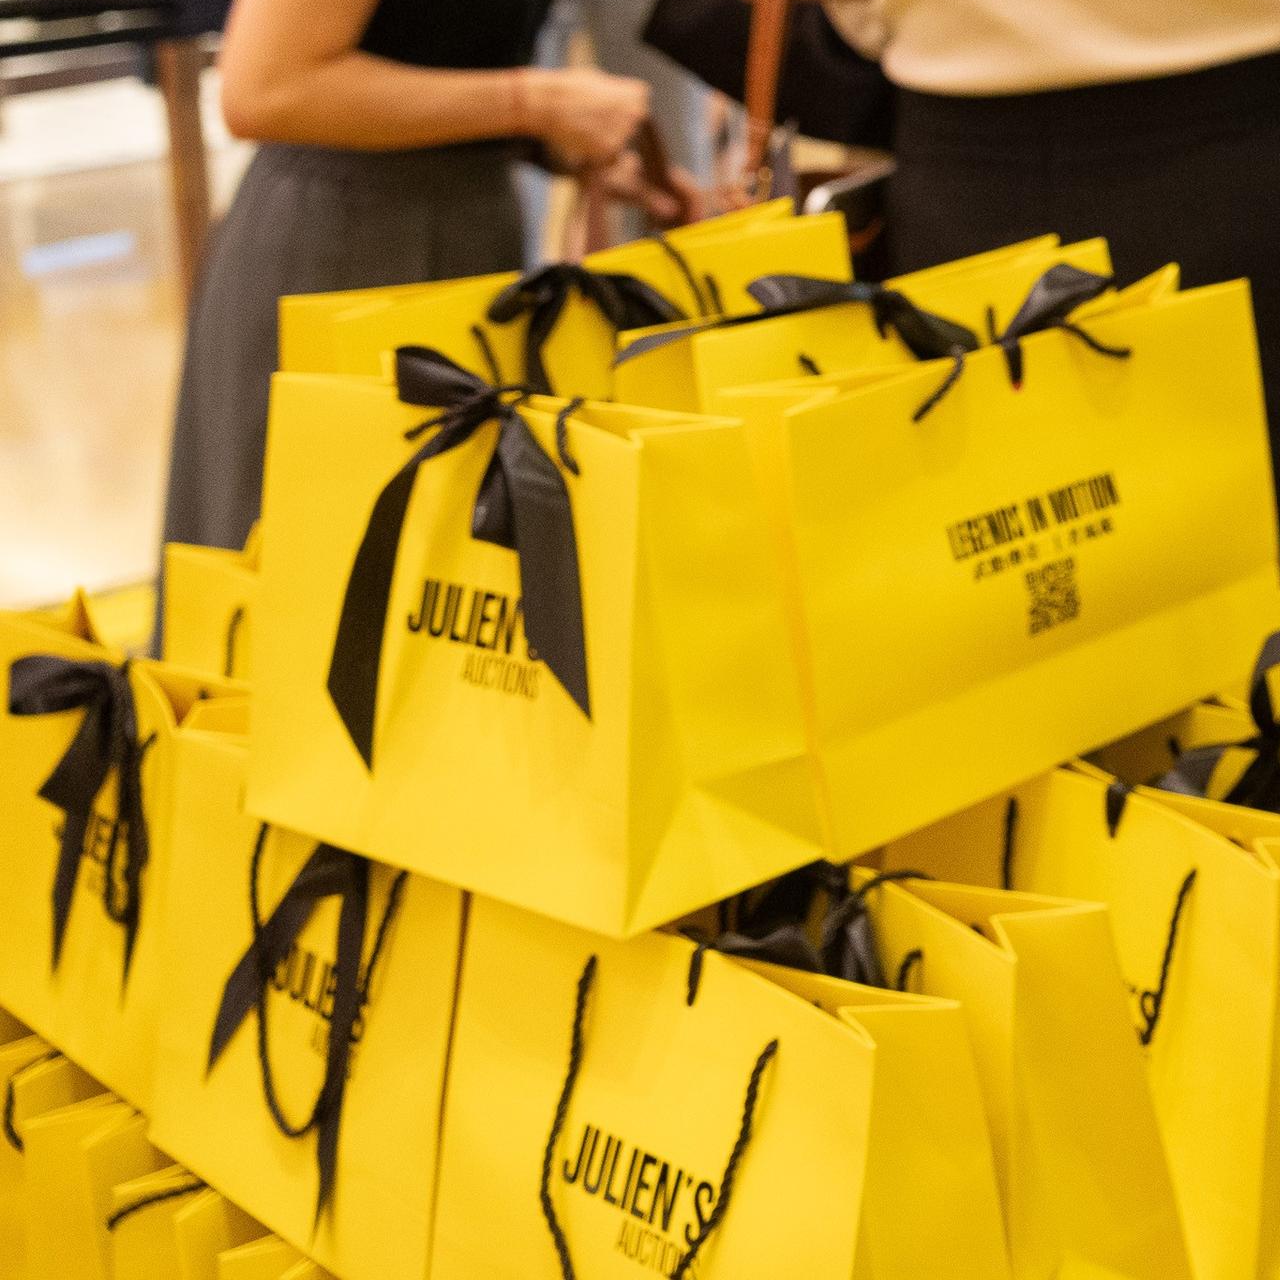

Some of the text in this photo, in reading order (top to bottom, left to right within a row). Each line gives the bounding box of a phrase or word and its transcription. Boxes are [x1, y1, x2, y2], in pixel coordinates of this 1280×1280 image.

[407, 578, 542, 661] JULIEN
[562, 1122, 715, 1247] JULIEN'S
[613, 1219, 700, 1280] AUCTIO
